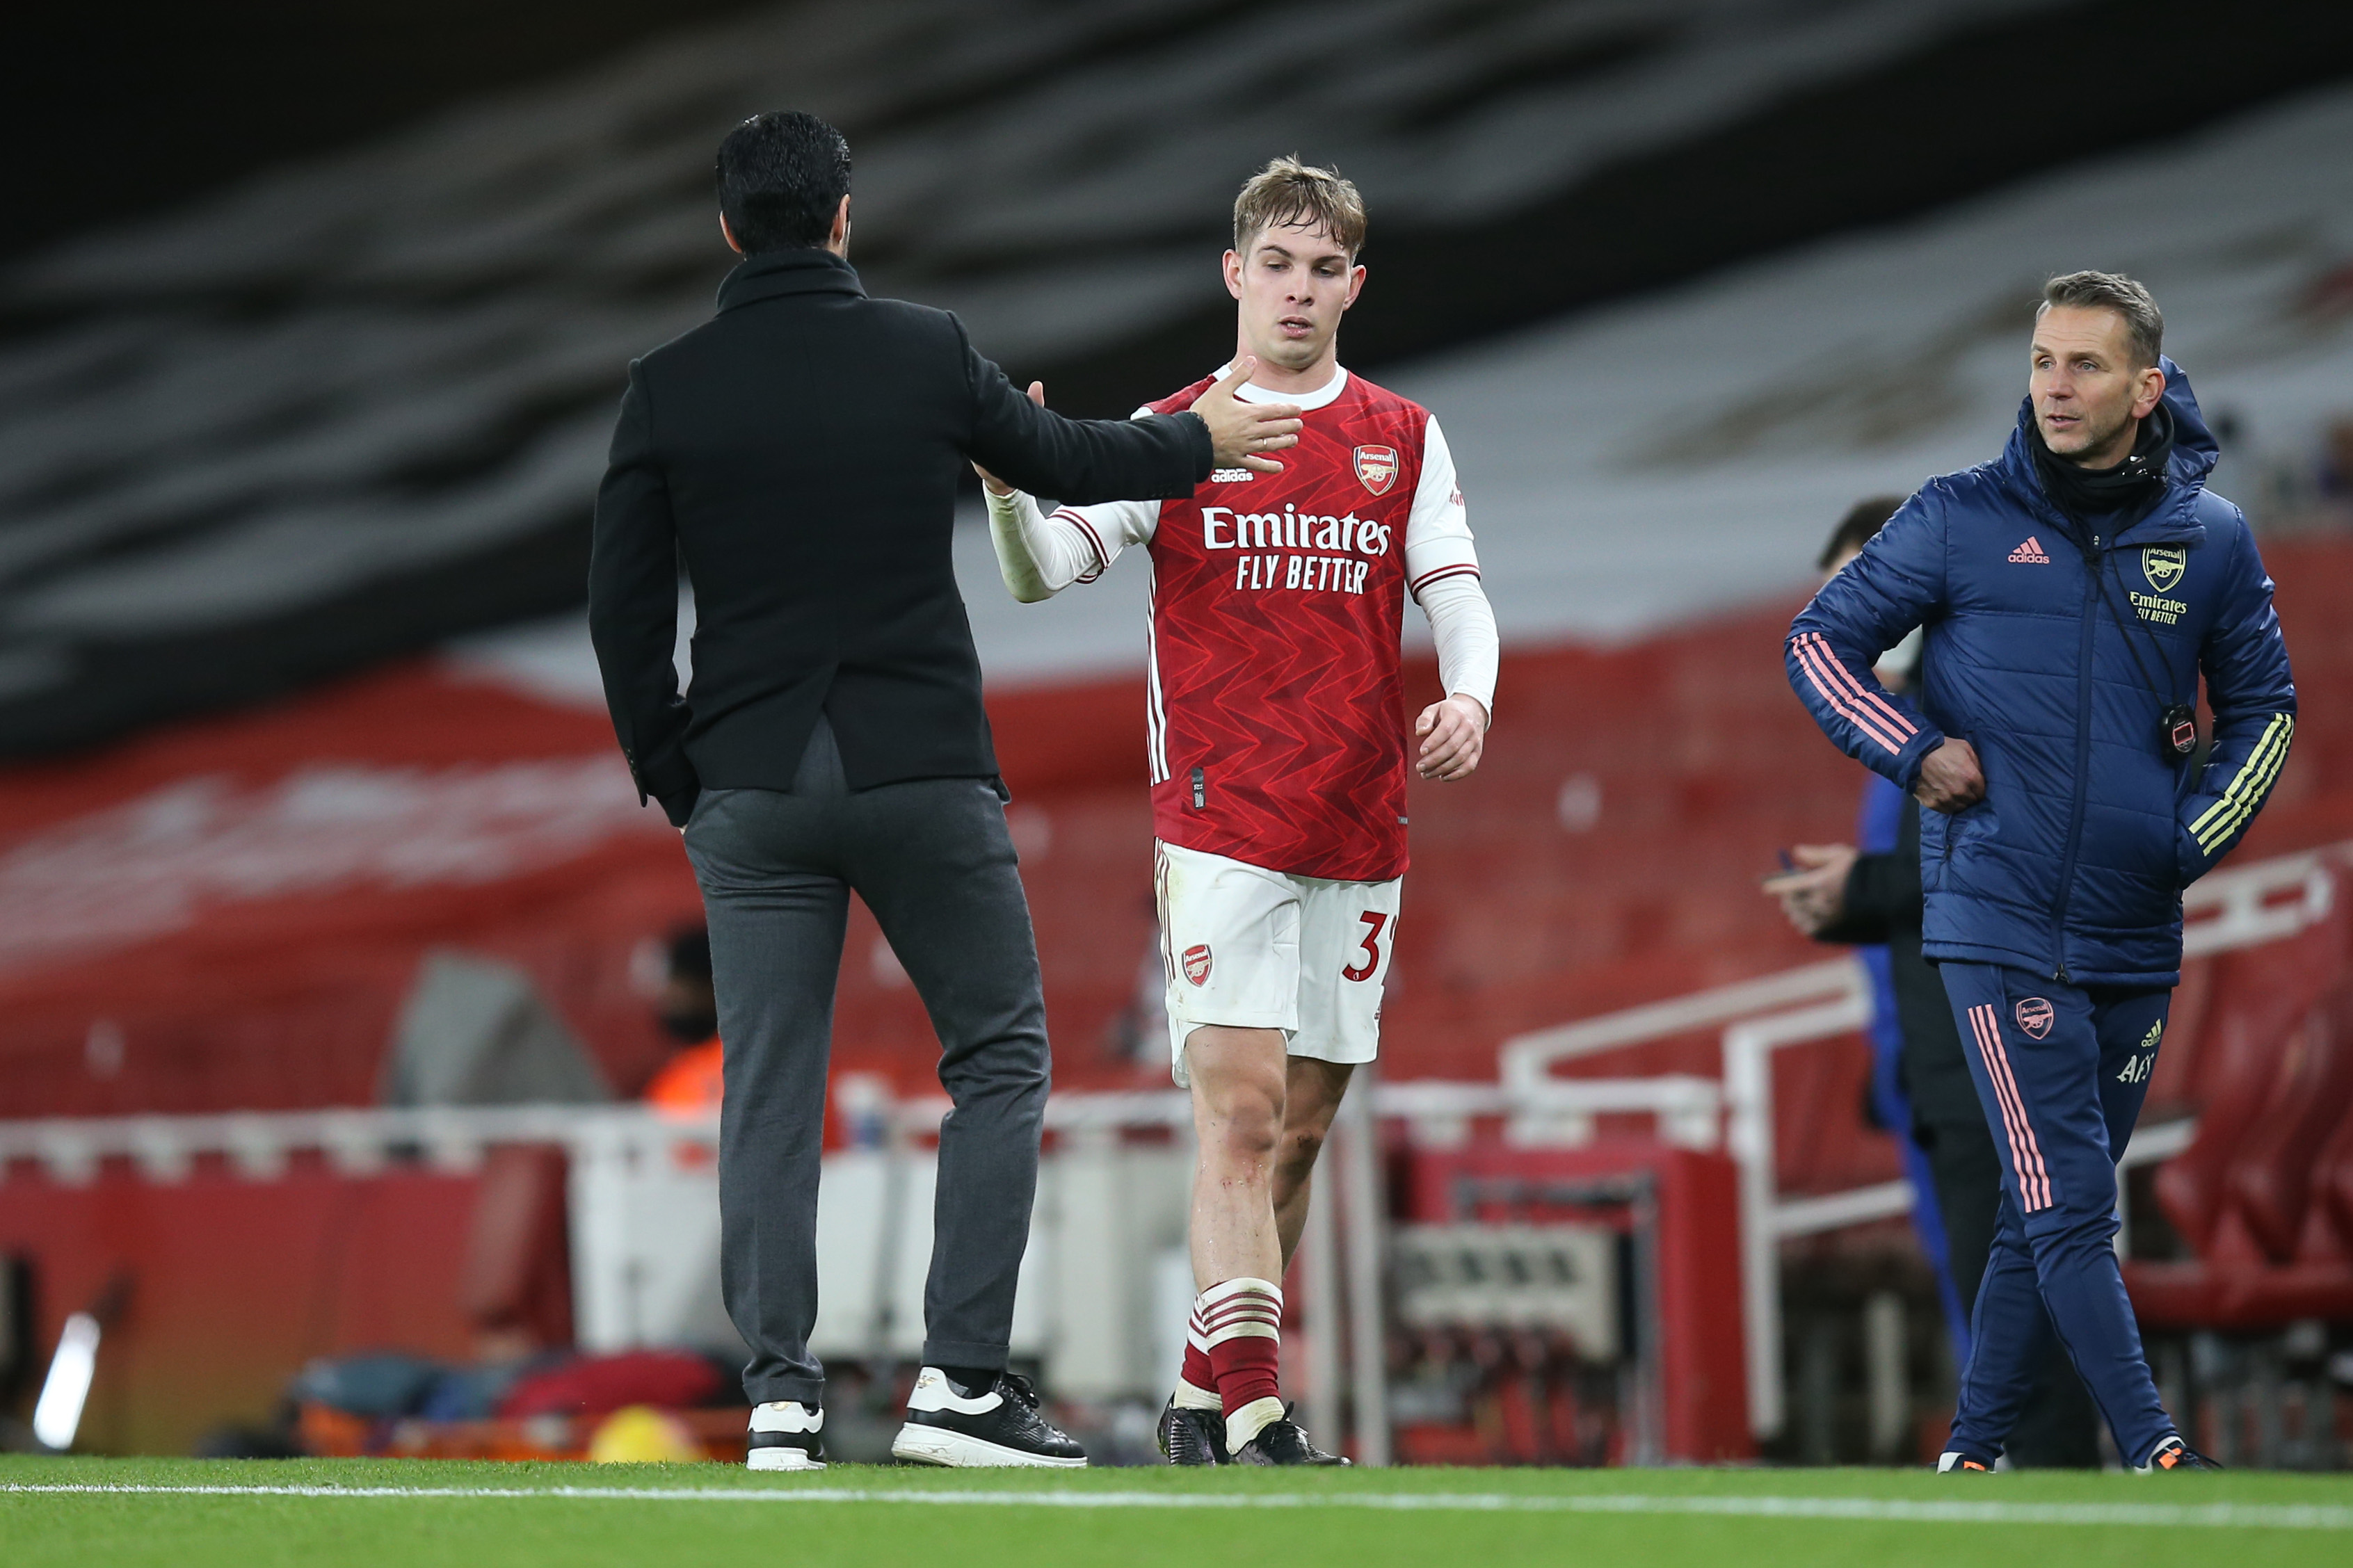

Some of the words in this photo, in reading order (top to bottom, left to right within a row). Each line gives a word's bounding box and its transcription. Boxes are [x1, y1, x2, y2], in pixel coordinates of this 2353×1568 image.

[1360, 451, 1392, 462] Arsenal
[1211, 469, 1254, 483] adidas
[1200, 503, 1391, 556] Emirates
[2007, 553, 2050, 564] adidas
[2150, 548, 2180, 559] Arsenal
[1236, 554, 1279, 590] FLY
[1286, 556, 1369, 595] BETTER
[2130, 591, 2187, 614] Emirates
[2150, 610, 2178, 625] BETTER
[1342, 910, 1397, 982] 3
[2022, 1004, 2048, 1014] Arsenal
